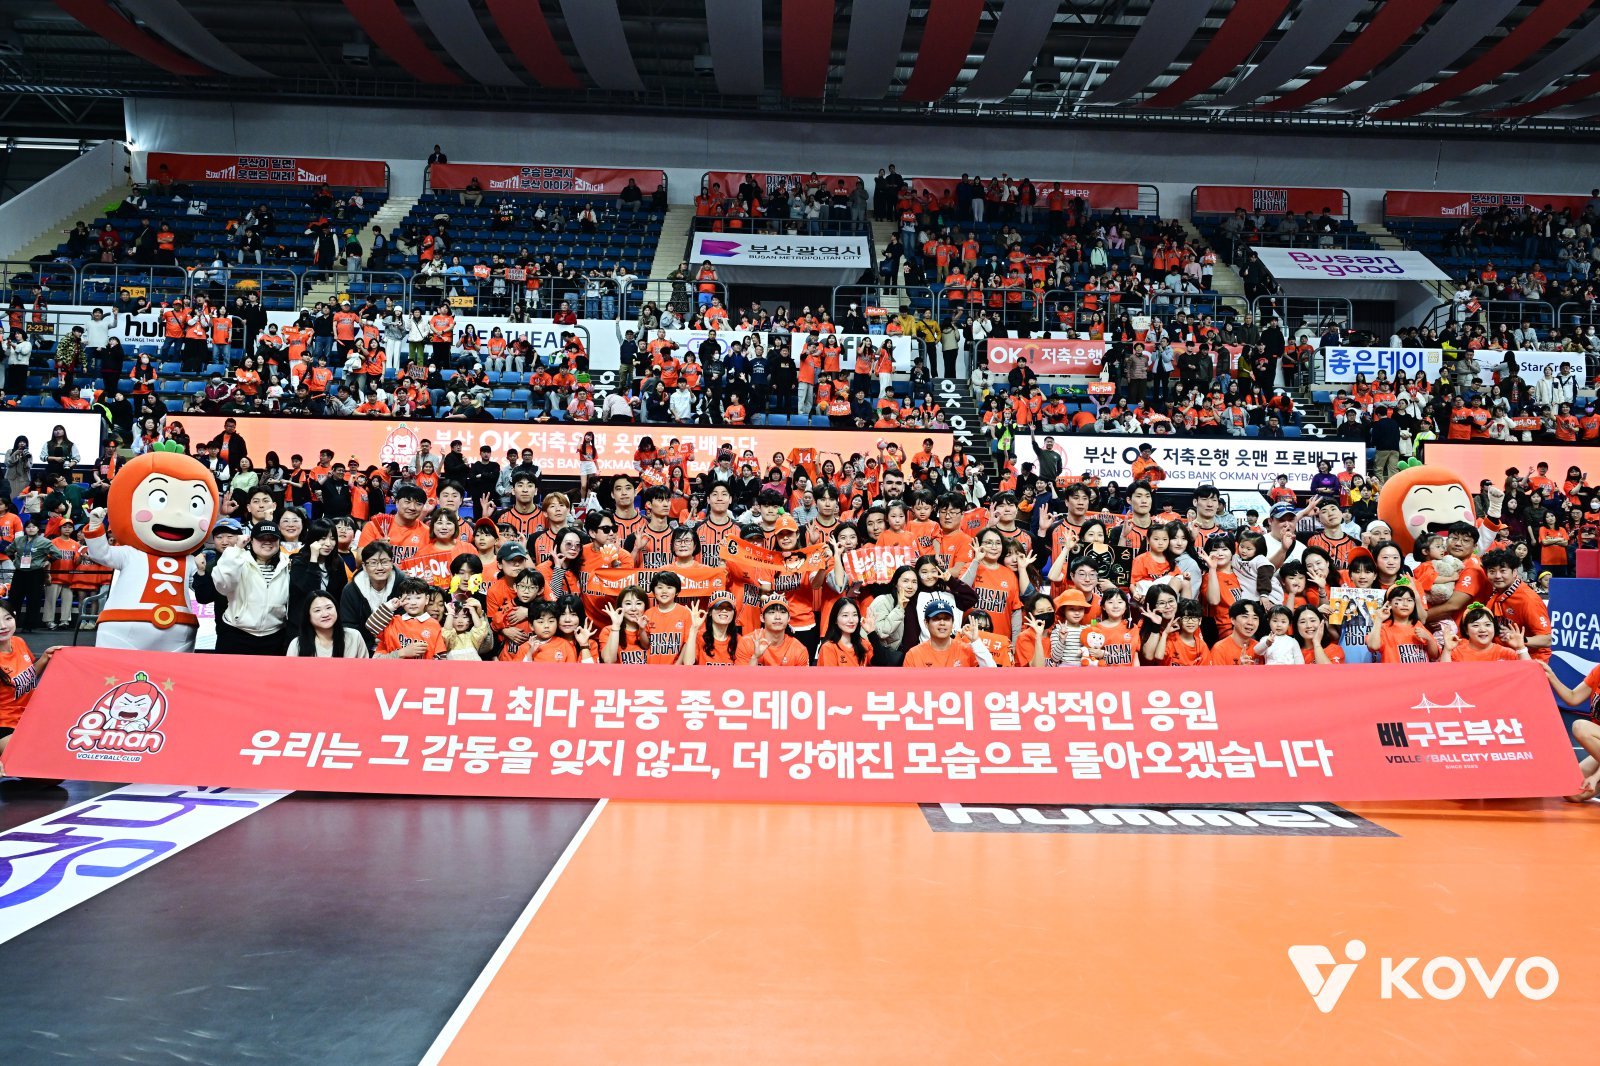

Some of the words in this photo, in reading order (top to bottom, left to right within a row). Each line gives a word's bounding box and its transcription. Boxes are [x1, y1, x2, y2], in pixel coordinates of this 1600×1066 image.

[238, 158, 269, 168] 부산이
[521, 168, 541, 178] 우승
[544, 168, 574, 179] 광역시
[520, 179, 541, 189] 부산
[544, 180, 574, 190] 아이가
[1252, 189, 1288, 212] BUSAN
[1471, 194, 1500, 204] 부산이
[748, 244, 862, 256] 부산광역시
[1288, 251, 1397, 265] Busan
[1322, 264, 1405, 276] good
[27, 324, 44, 332] 2-23
[990, 346, 1019, 364] OK
[1041, 347, 1103, 366] 저축은행
[1328, 349, 1424, 376] 좋은데이
[939, 380, 962, 408] 읏
[433, 430, 474, 451] 부산
[480, 430, 523, 452] OK
[798, 452, 812, 464] 14
[1084, 446, 1117, 464] 부산
[1163, 448, 1230, 467] 저축은행
[1235, 449, 1268, 468] 읏맨
[1274, 450, 1358, 469] 프로배구단
[1086, 468, 1120, 478] BUSAN
[1188, 471, 1216, 480] BANK
[1220, 472, 1258, 480] OKMAN
[728, 540, 738, 554] 6
[152, 557, 183, 596] 읏
[430, 558, 450, 578] OK
[774, 572, 802, 592] BUSAN
[974, 588, 1008, 613] BUSAN
[1551, 610, 1600, 632] POCA
[650, 632, 681, 656] BUSAN
[1345, 624, 1373, 646] BUSA
[621, 650, 648, 664] BUSA
[374, 686, 497, 726] V-리그
[505, 686, 584, 728] 최다
[590, 688, 668, 730] 관중
[676, 688, 852, 730] 좋은데이~
[862, 690, 974, 731] 부산의
[984, 690, 1134, 732] 열성적인
[1142, 690, 1218, 732] 응원
[1376, 718, 1526, 748] 배구도부산
[77, 753, 121, 761] VOLLEYBALL
[239, 730, 362, 770] 우리는
[368, 734, 410, 766] 그
[421, 734, 538, 774] 감동을
[550, 738, 624, 776] 잊지
[636, 740, 720, 780] 않고,
[733, 740, 768, 778] 더
[780, 739, 894, 780] 강해진
[904, 740, 1058, 780] 모습으로
[1064, 738, 1334, 780] 돌아오겠습니다
[1385, 752, 1461, 764] VOLLEYBALL
[1462, 752, 1490, 762] CITY
[1491, 751, 1534, 761] BUSAN
[938, 802, 1359, 830] hummel
